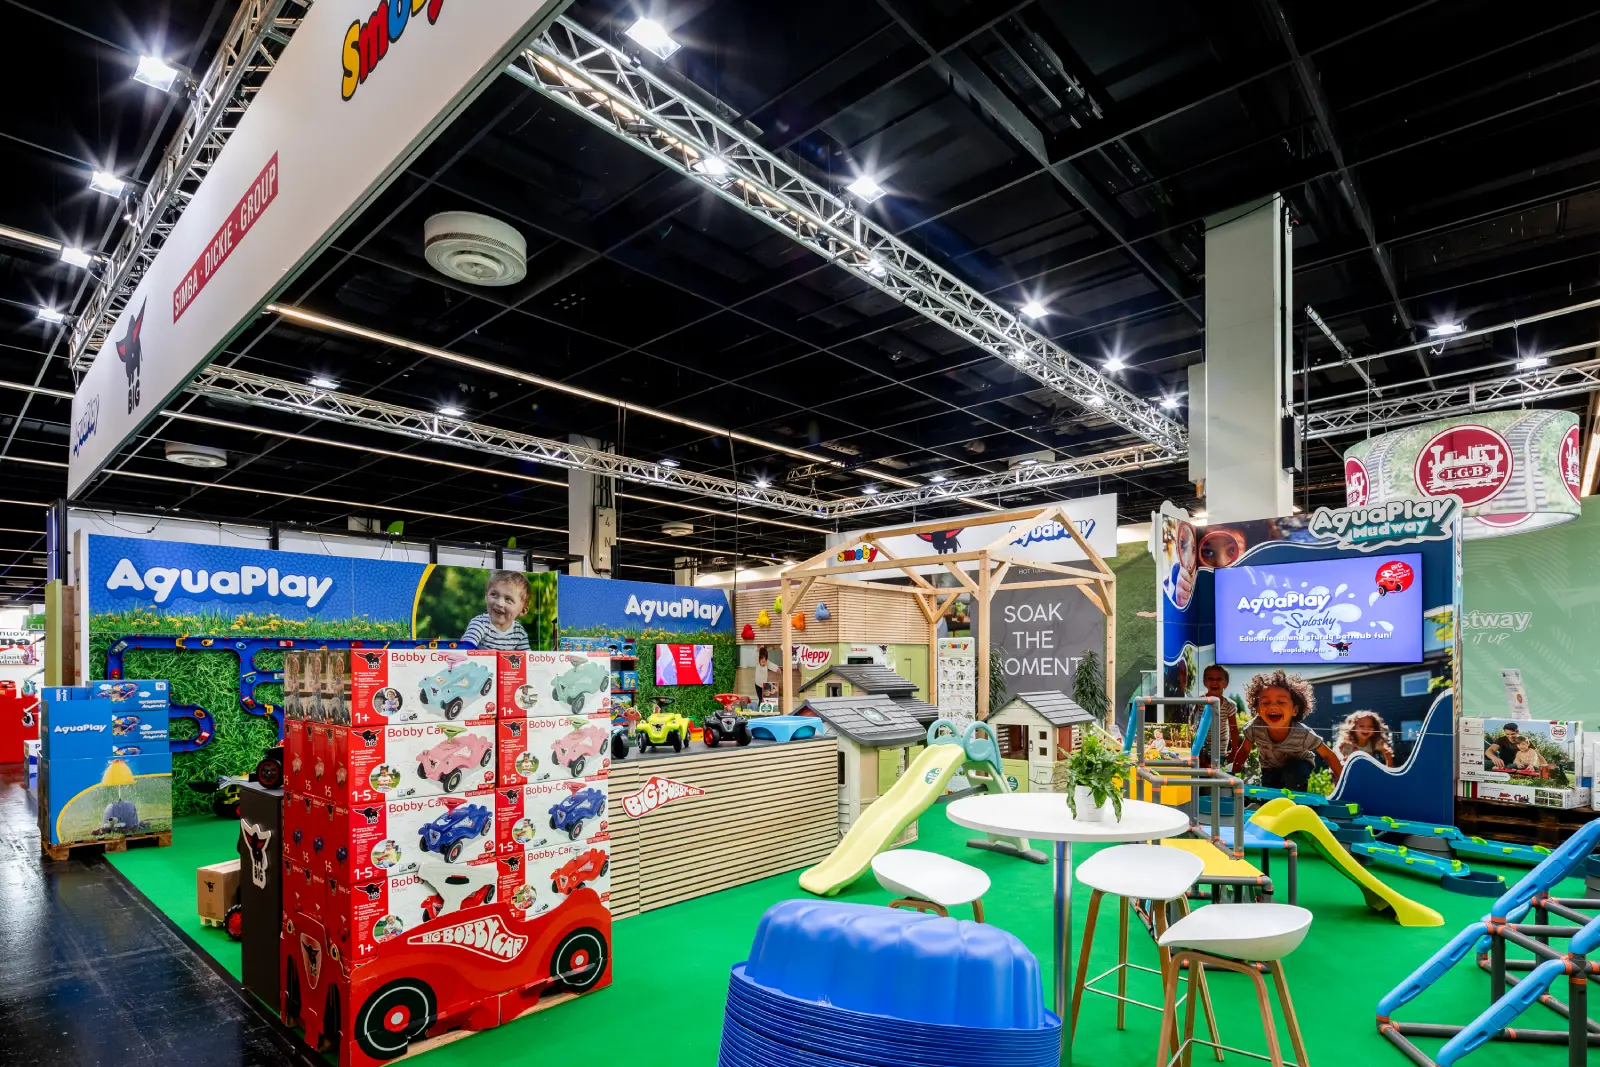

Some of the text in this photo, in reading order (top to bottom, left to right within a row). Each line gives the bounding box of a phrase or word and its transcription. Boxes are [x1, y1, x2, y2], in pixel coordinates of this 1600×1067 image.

[341, 0, 445, 102] smo
[173, 163, 277, 316] SIMBA DICKIE GROUP
[127, 379, 140, 415] BIG
[1313, 498, 1455, 534] AquaPlay
[1352, 519, 1429, 539] Mudway
[837, 545, 879, 563] smoby
[106, 558, 333, 608] AquaPlay
[625, 594, 724, 626] AquaPlay
[1237, 593, 1331, 614] AquaPlay
[1004, 602, 1063, 623] SOAK
[1285, 611, 1336, 633] Sploshy
[1012, 630, 1054, 649] THE
[1239, 635, 1287, 643] Educational
[1306, 634, 1334, 642] sturdy
[1336, 632, 1371, 640] bathtub
[1374, 631, 1392, 639] fun!
[1472, 632, 1488, 645] IT
[1488, 632, 1510, 645] UP
[391, 652, 448, 664] Bobby Car
[528, 653, 573, 664] Bobby Car
[801, 646, 829, 663] Heppy
[1000, 657, 1083, 676] OMENT
[354, 712, 370, 724] 1+
[501, 706, 514, 717] 1+
[54, 723, 107, 735] AquaPlay
[528, 718, 573, 729] Bobby Car
[387, 725, 446, 738] Bobby Car
[502, 773, 518, 784] 1-5
[352, 789, 372, 802] 1-5
[525, 782, 570, 795] Bobby-Car
[389, 799, 446, 813] Bobby-Car
[498, 841, 514, 853] 1-5
[527, 846, 573, 861] Bobby-Car
[254, 865, 264, 882] BIG
[353, 866, 373, 880] 1-5
[391, 874, 425, 888] Bobby
[357, 943, 374, 956] 1+
